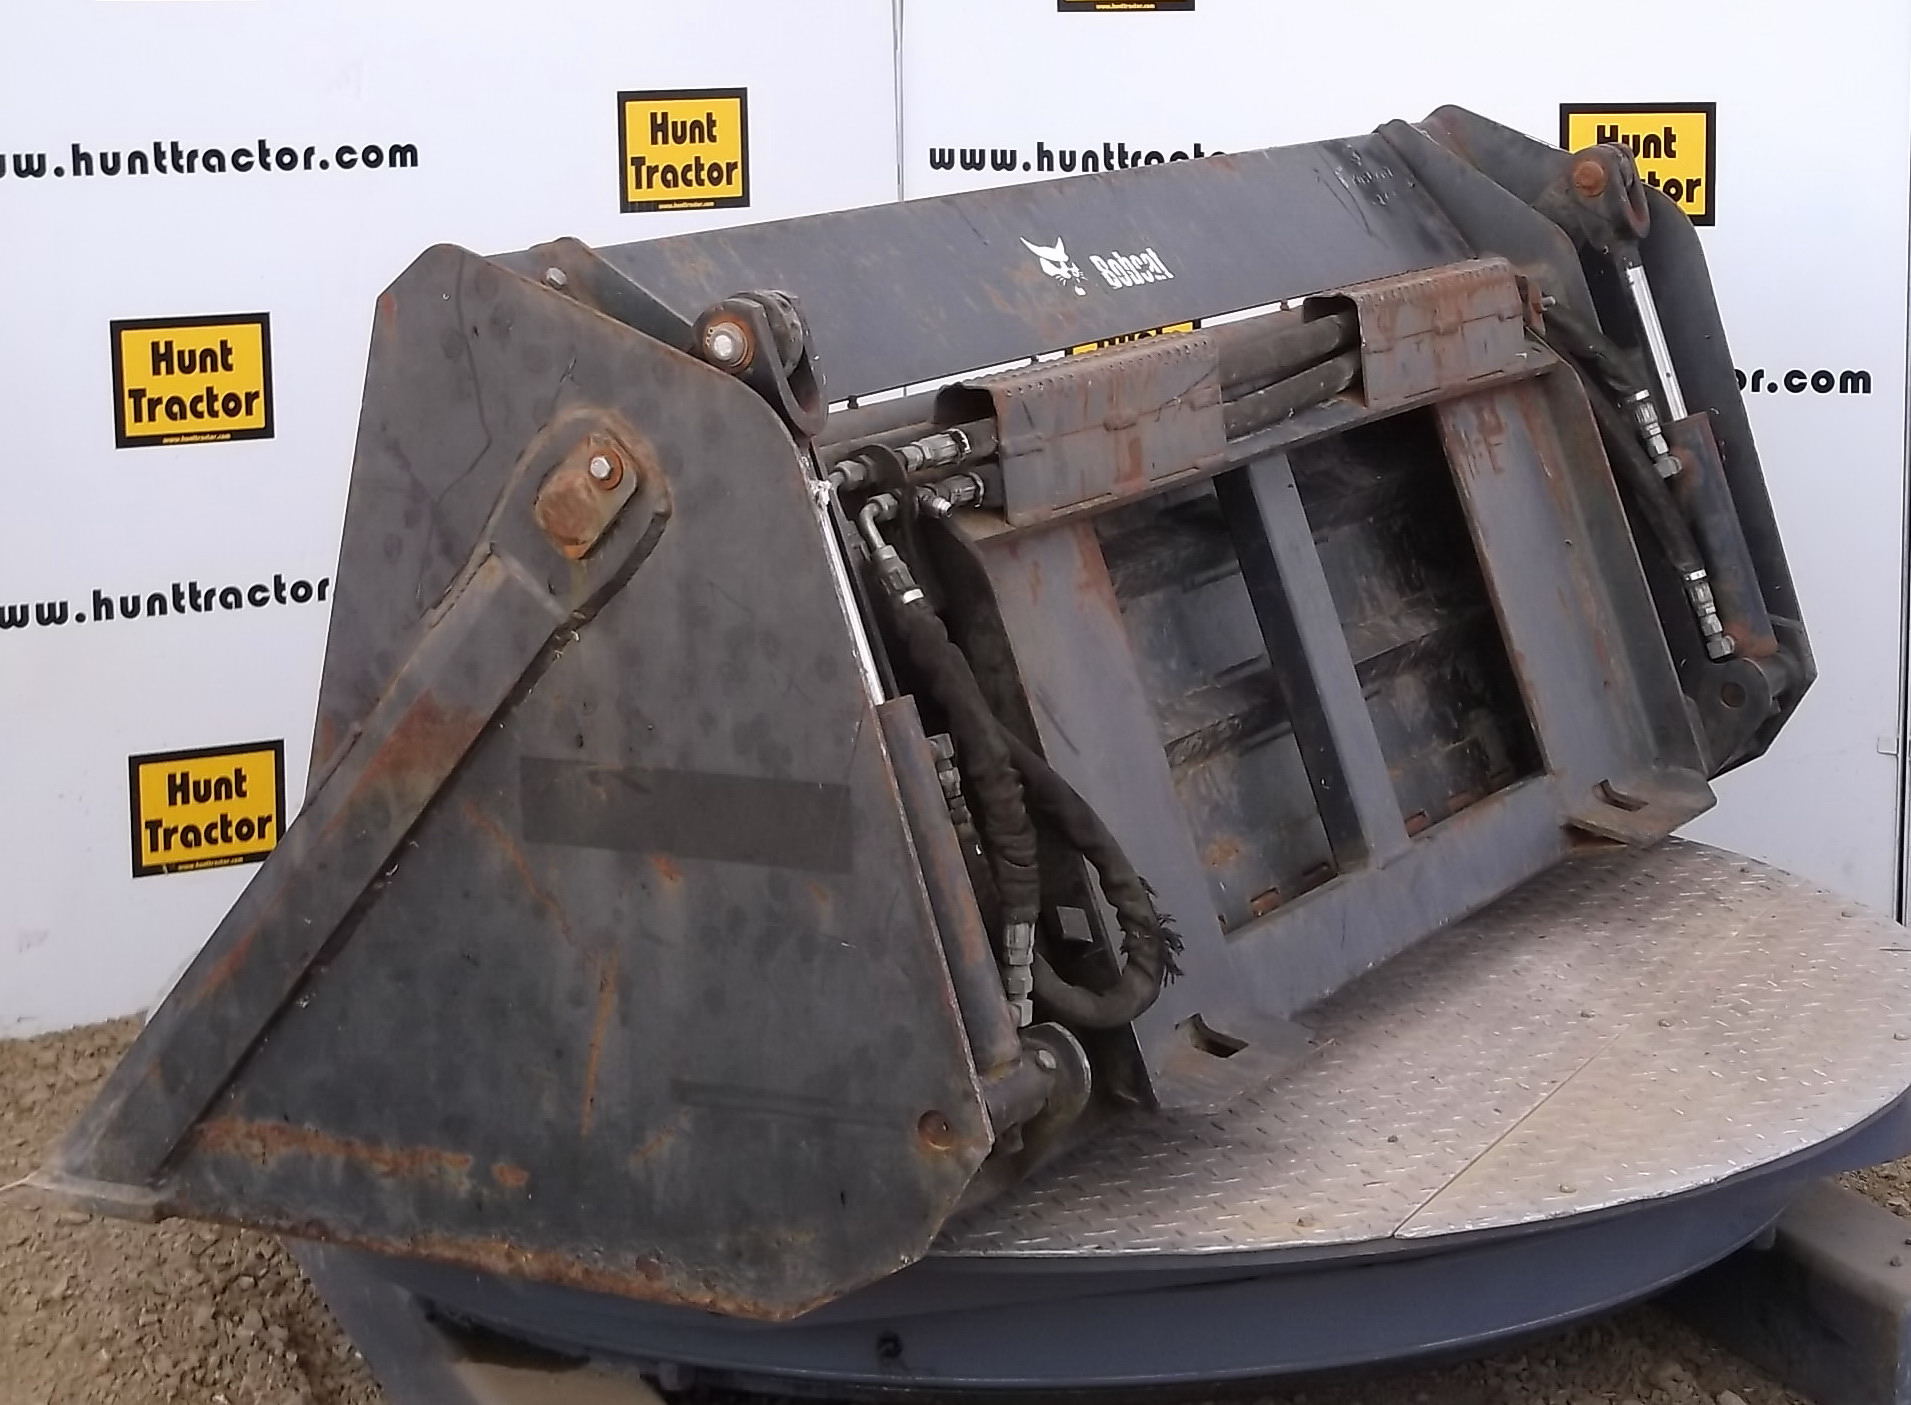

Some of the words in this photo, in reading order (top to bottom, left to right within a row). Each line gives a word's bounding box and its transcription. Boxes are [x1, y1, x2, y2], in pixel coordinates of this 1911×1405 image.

[650, 111, 718, 145] Hunt
[631, 155, 739, 189] Tractor
[1088, 247, 1175, 290] Bobcat
[150, 339, 234, 376] Hunt
[128, 385, 260, 423] Tractor
[168, 768, 248, 806] Hunt
[145, 813, 273, 853] Tractor
